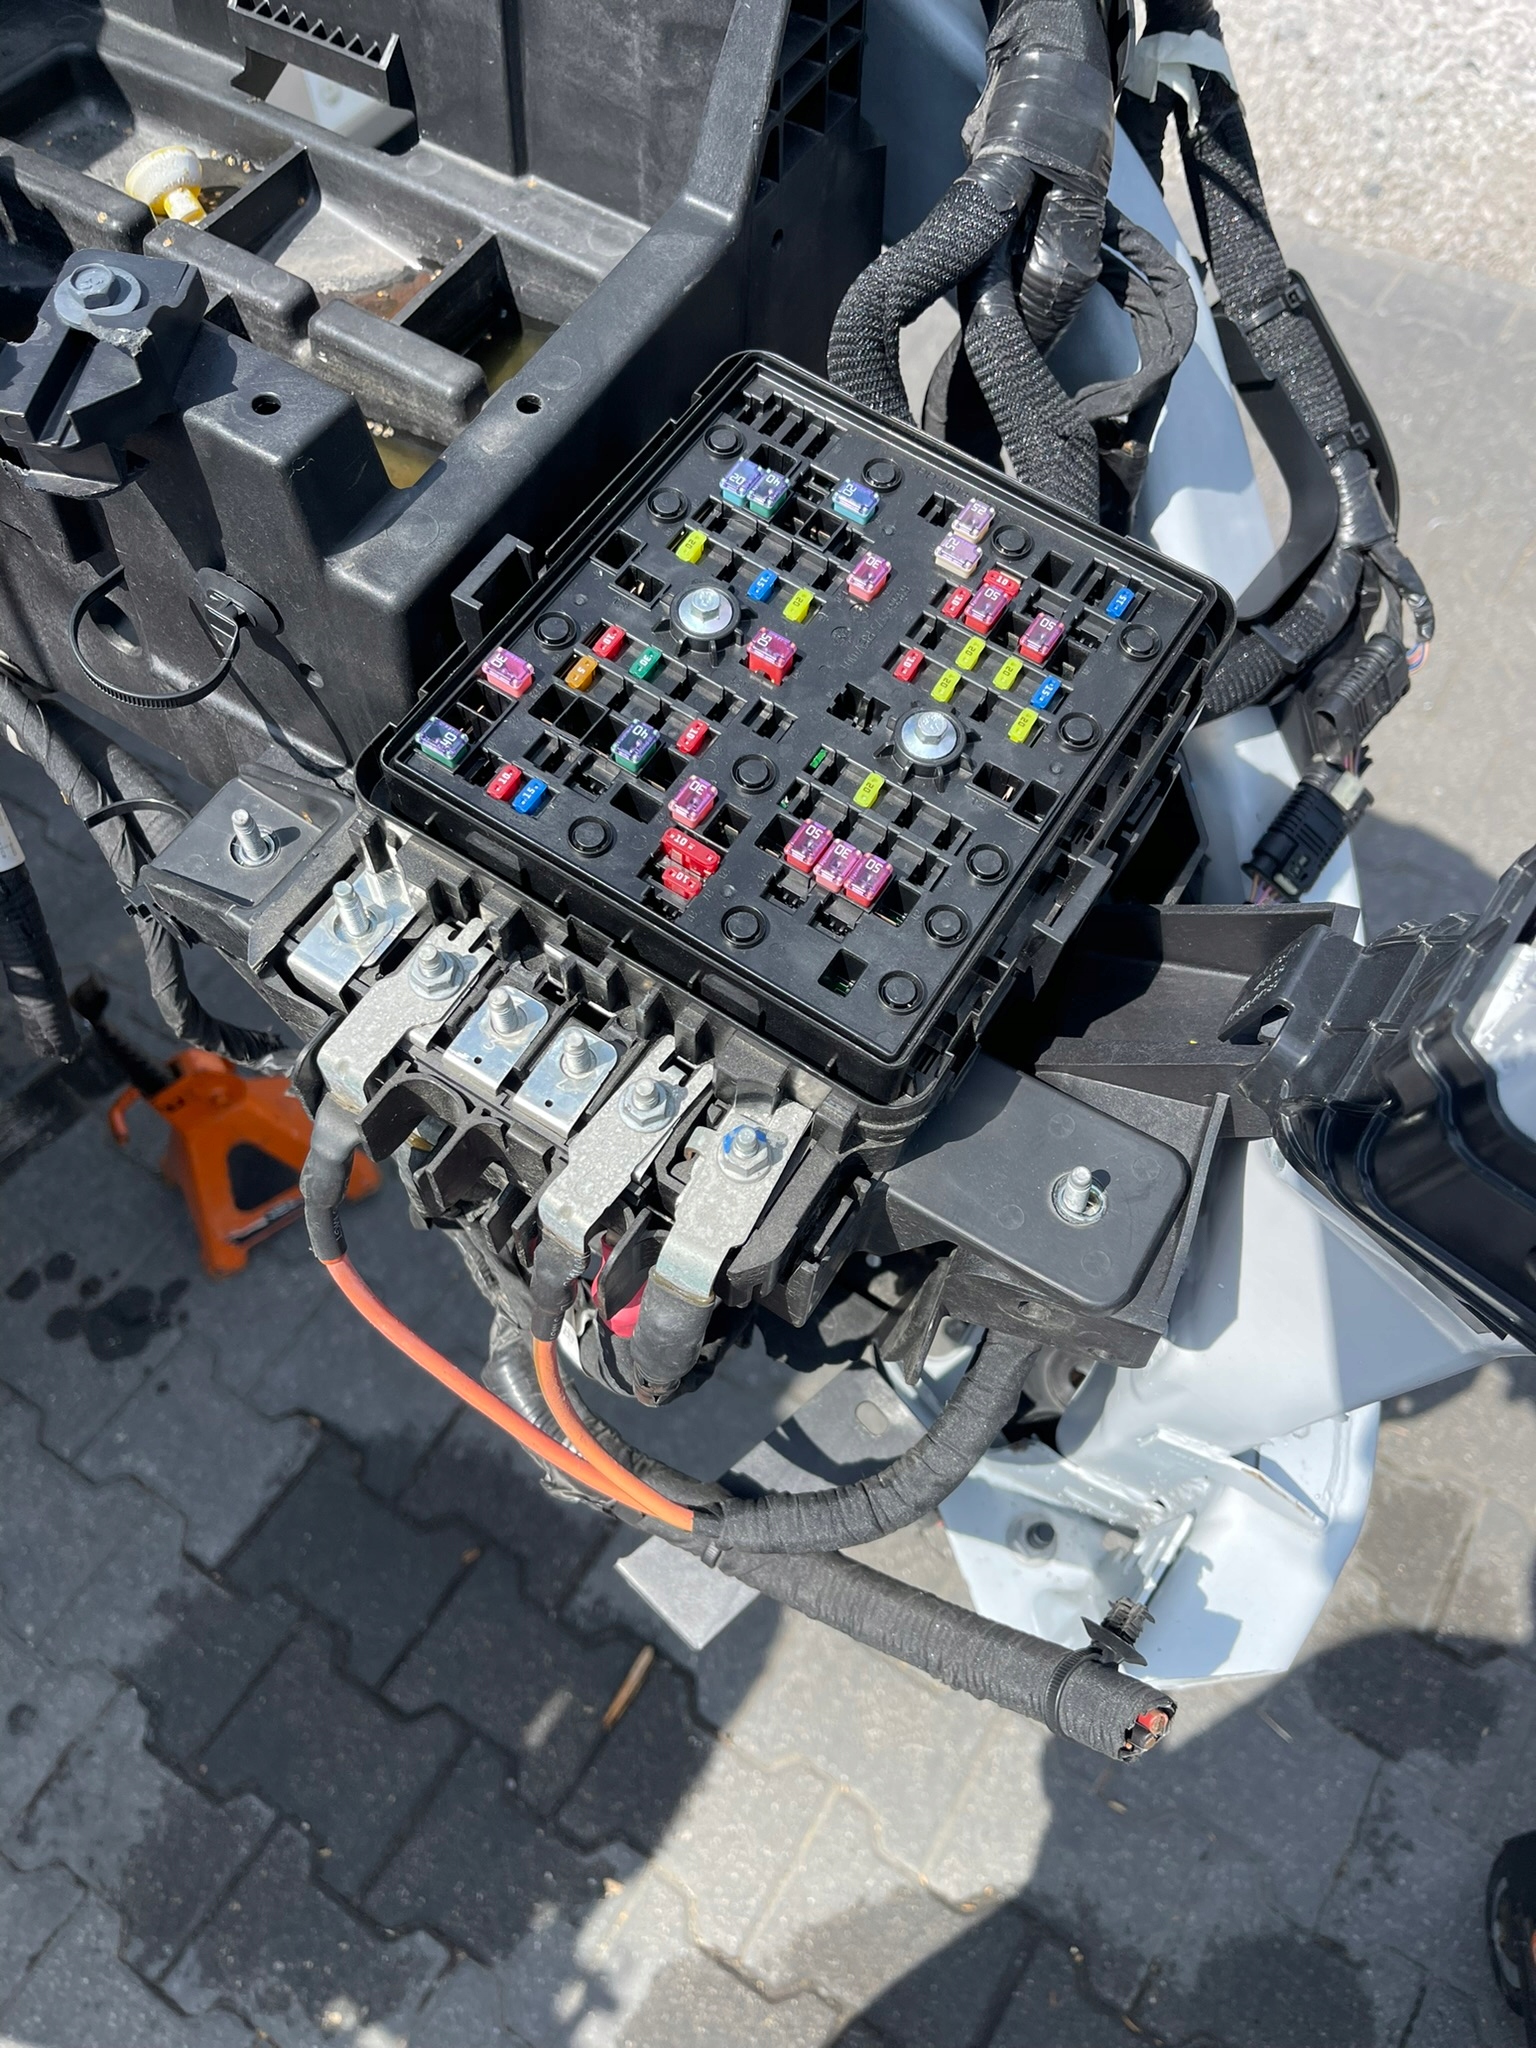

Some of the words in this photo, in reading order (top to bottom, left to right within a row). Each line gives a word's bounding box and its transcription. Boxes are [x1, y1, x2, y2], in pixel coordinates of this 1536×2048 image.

[729, 473, 745, 484] 20
[766, 474, 780, 486] 40
[843, 483, 857, 496] 20
[866, 557, 882, 569] 30
[757, 577, 768, 588] 15
[997, 575, 1008, 585] 10
[951, 595, 962, 606] 10
[984, 588, 1000, 601] 50
[1117, 594, 1127, 605] 15
[792, 596, 803, 607] 20
[1040, 617, 1056, 631] 50
[604, 633, 615, 645] 10
[757, 633, 772, 647] 50
[965, 645, 976, 656] 20
[490, 653, 508, 668] 30
[903, 657, 914, 668] 10
[1003, 666, 1013, 676] 20
[940, 677, 951, 688] 20
[1042, 685, 1053, 697] 15
[1017, 716, 1028, 727] 20
[632, 725, 648, 739] 40
[686, 728, 698, 739] 10
[440, 732, 457, 747] 40
[498, 772, 511, 784] 10
[523, 787, 536, 799] 15
[689, 780, 707, 796] 30
[863, 782, 874, 793] 20
[805, 825, 823, 839] 50
[674, 834, 688, 845] 10
[835, 844, 852, 859] 30
[865, 859, 883, 874] 50
[675, 872, 690, 883] 10
